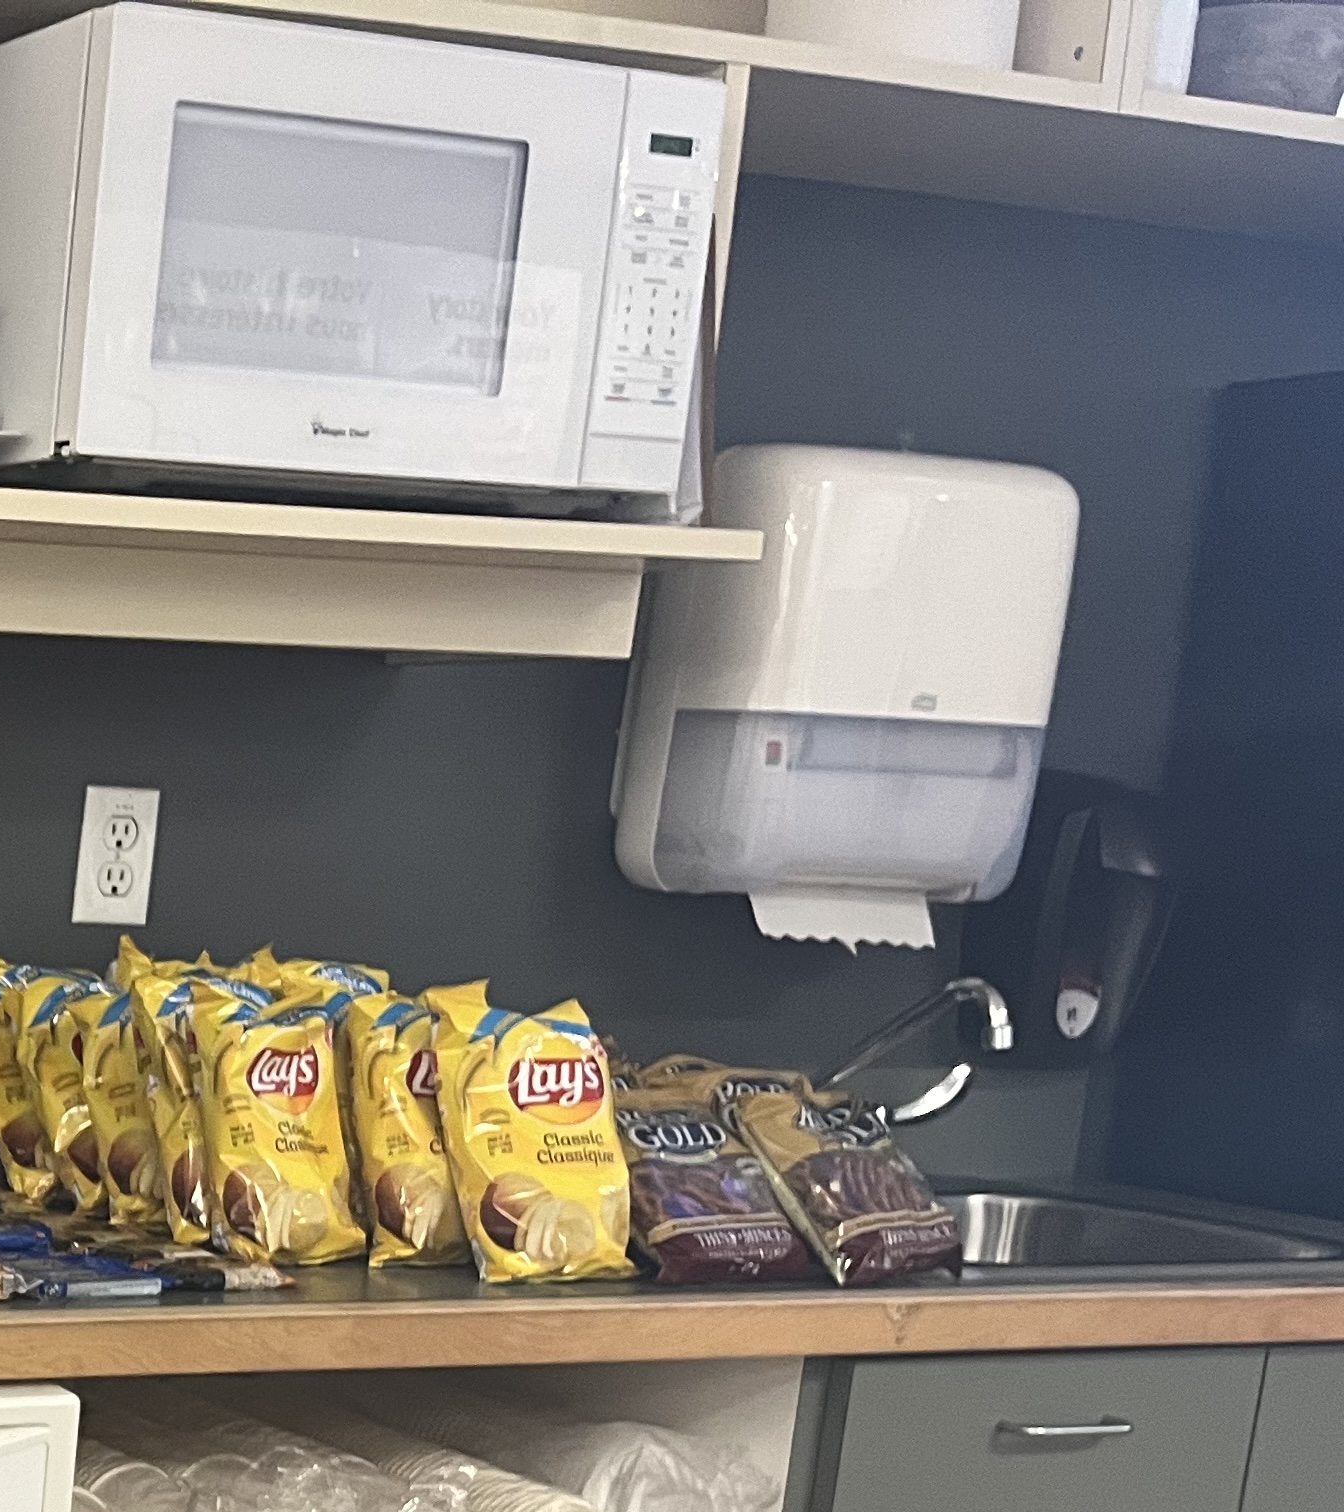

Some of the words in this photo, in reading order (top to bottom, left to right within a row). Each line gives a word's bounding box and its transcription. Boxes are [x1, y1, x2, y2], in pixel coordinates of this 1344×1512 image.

[543, 1129, 604, 1148] Classic
[628, 1121, 727, 1149] GOLD
[536, 1148, 614, 1167] Classique
